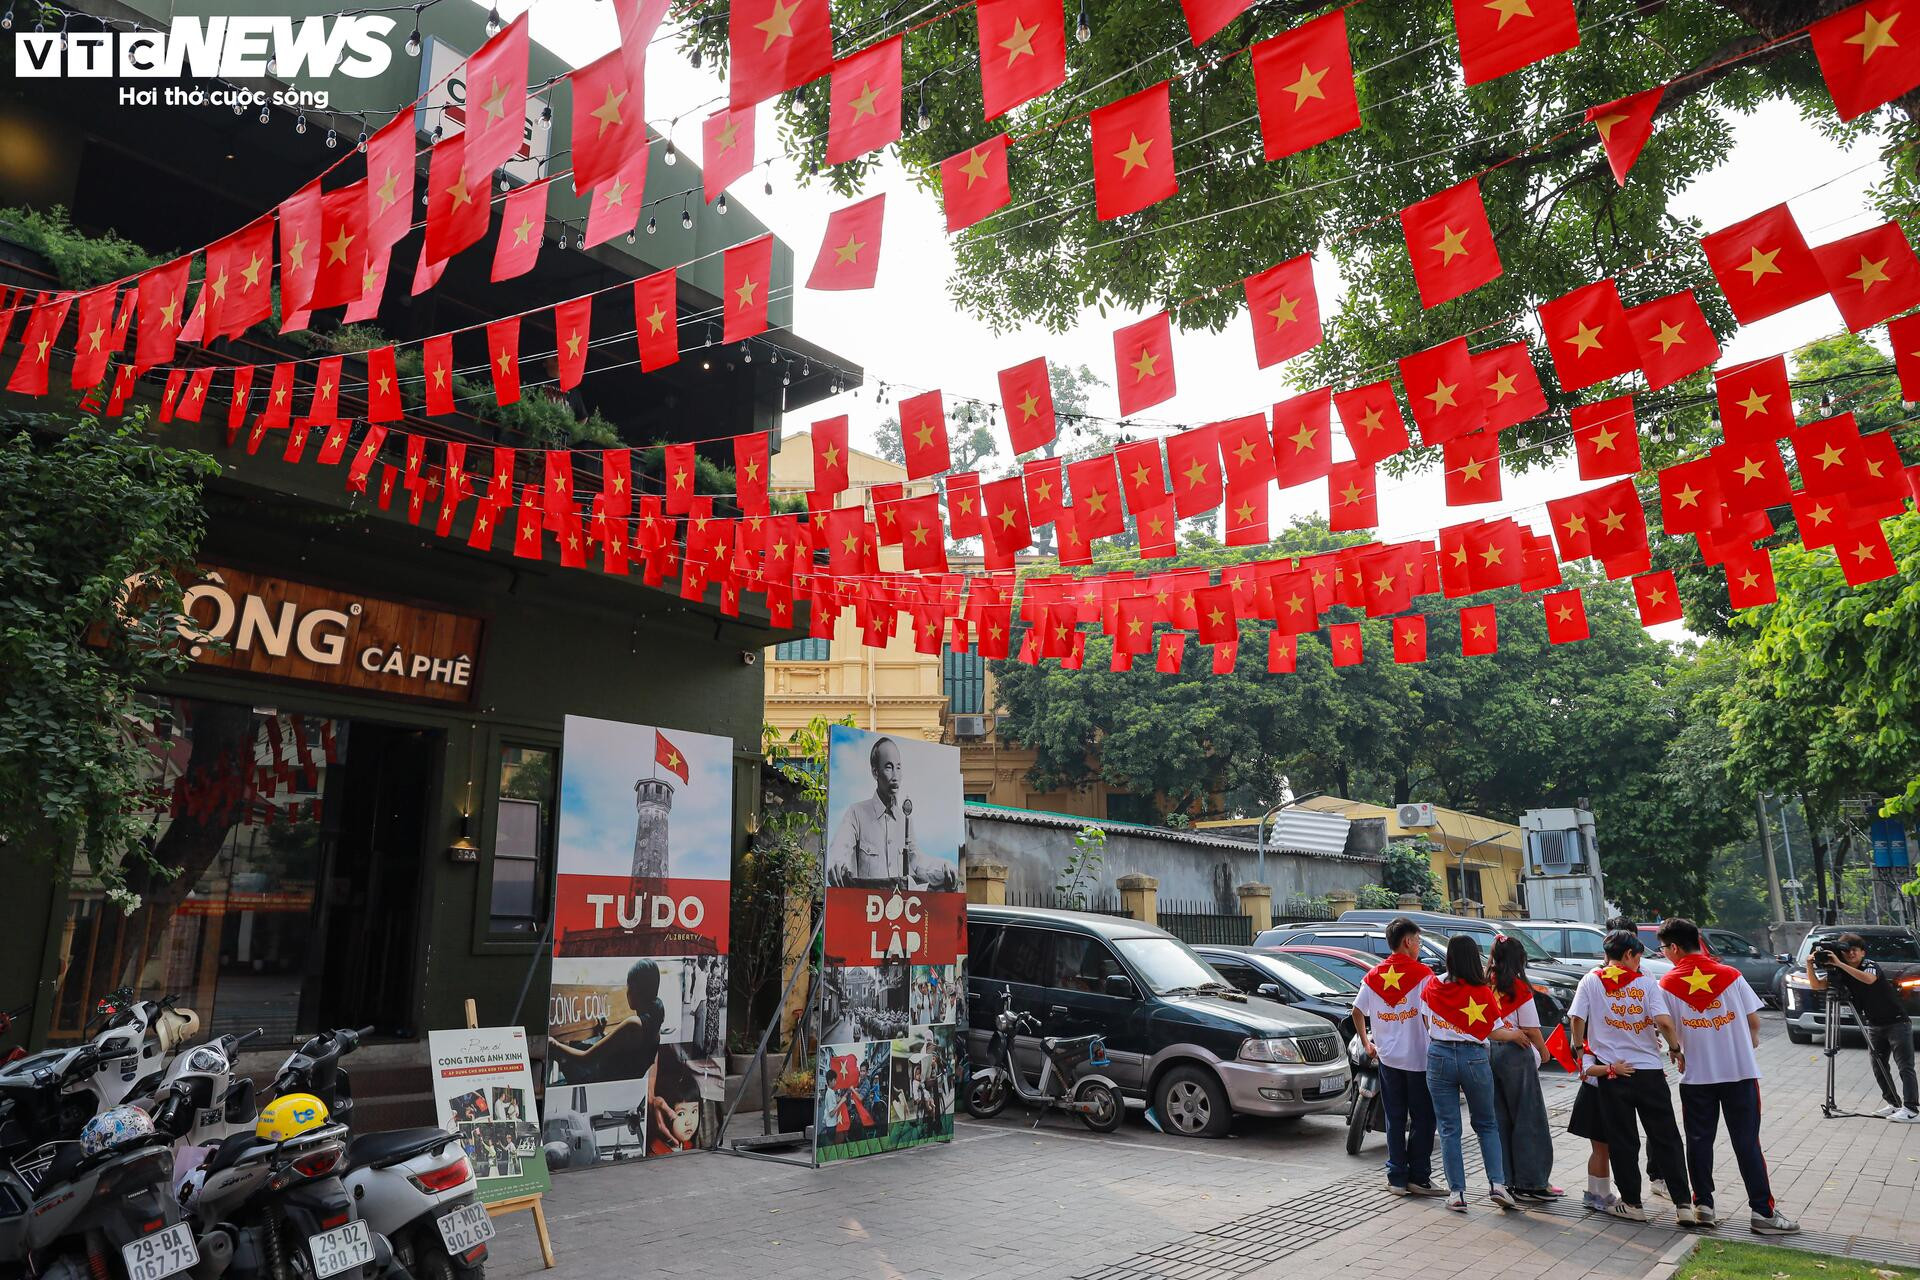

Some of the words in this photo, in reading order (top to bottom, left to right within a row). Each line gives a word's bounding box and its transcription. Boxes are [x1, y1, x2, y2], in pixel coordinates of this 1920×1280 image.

[410, 654, 471, 686] PHÊ
[586, 892, 648, 934] TỰ
[650, 895, 705, 929] DO
[870, 924, 921, 965] LẬP
[1627, 1003, 1643, 1015] do
[292, 1108, 315, 1124] be
[133, 1229, 182, 1263] 29-BA
[320, 1225, 361, 1254] 29-D2
[448, 1222, 491, 1252] 902.69
[134, 1245, 194, 1280] 067.75
[317, 1241, 368, 1274] 580.17
